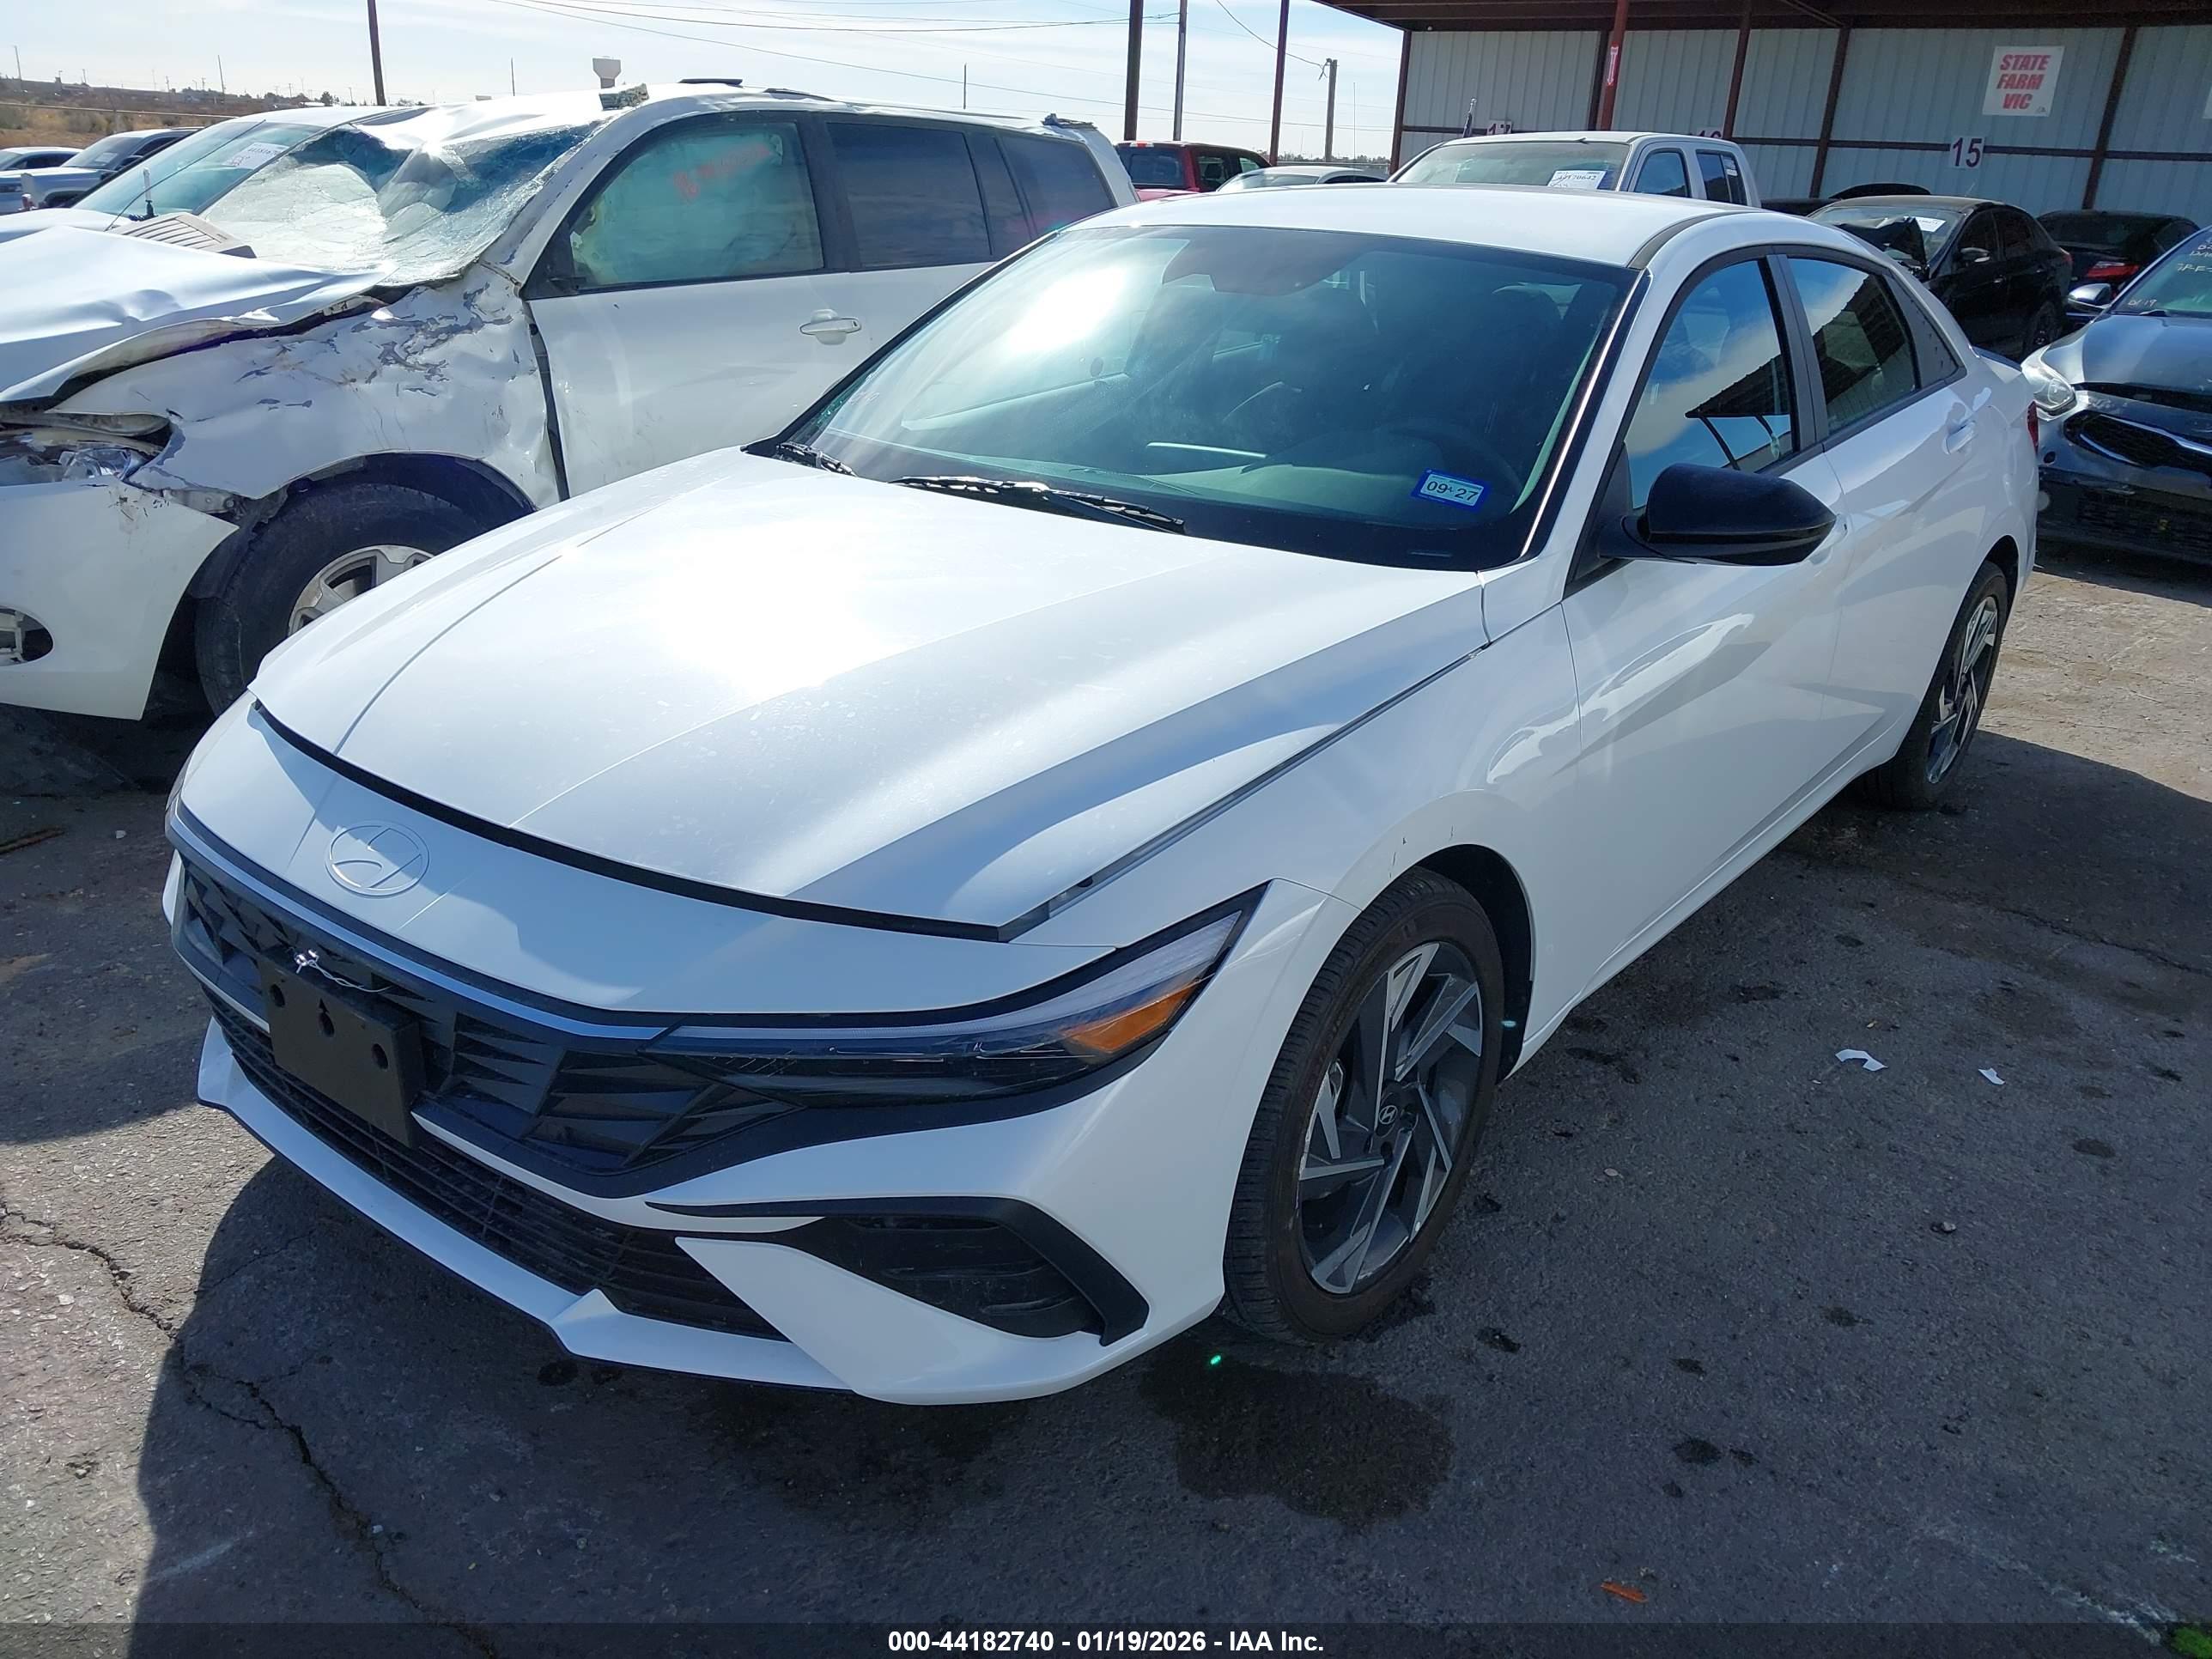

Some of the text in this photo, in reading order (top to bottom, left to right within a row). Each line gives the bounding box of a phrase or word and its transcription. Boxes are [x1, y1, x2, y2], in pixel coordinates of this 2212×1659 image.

[2000, 54, 2052, 70] STATE
[1996, 74, 2045, 90] FARM
[2002, 94, 2033, 110] VIC
[1953, 137, 1983, 168] 15
[1427, 481, 1449, 494] 09
[1455, 488, 1480, 501] 27
